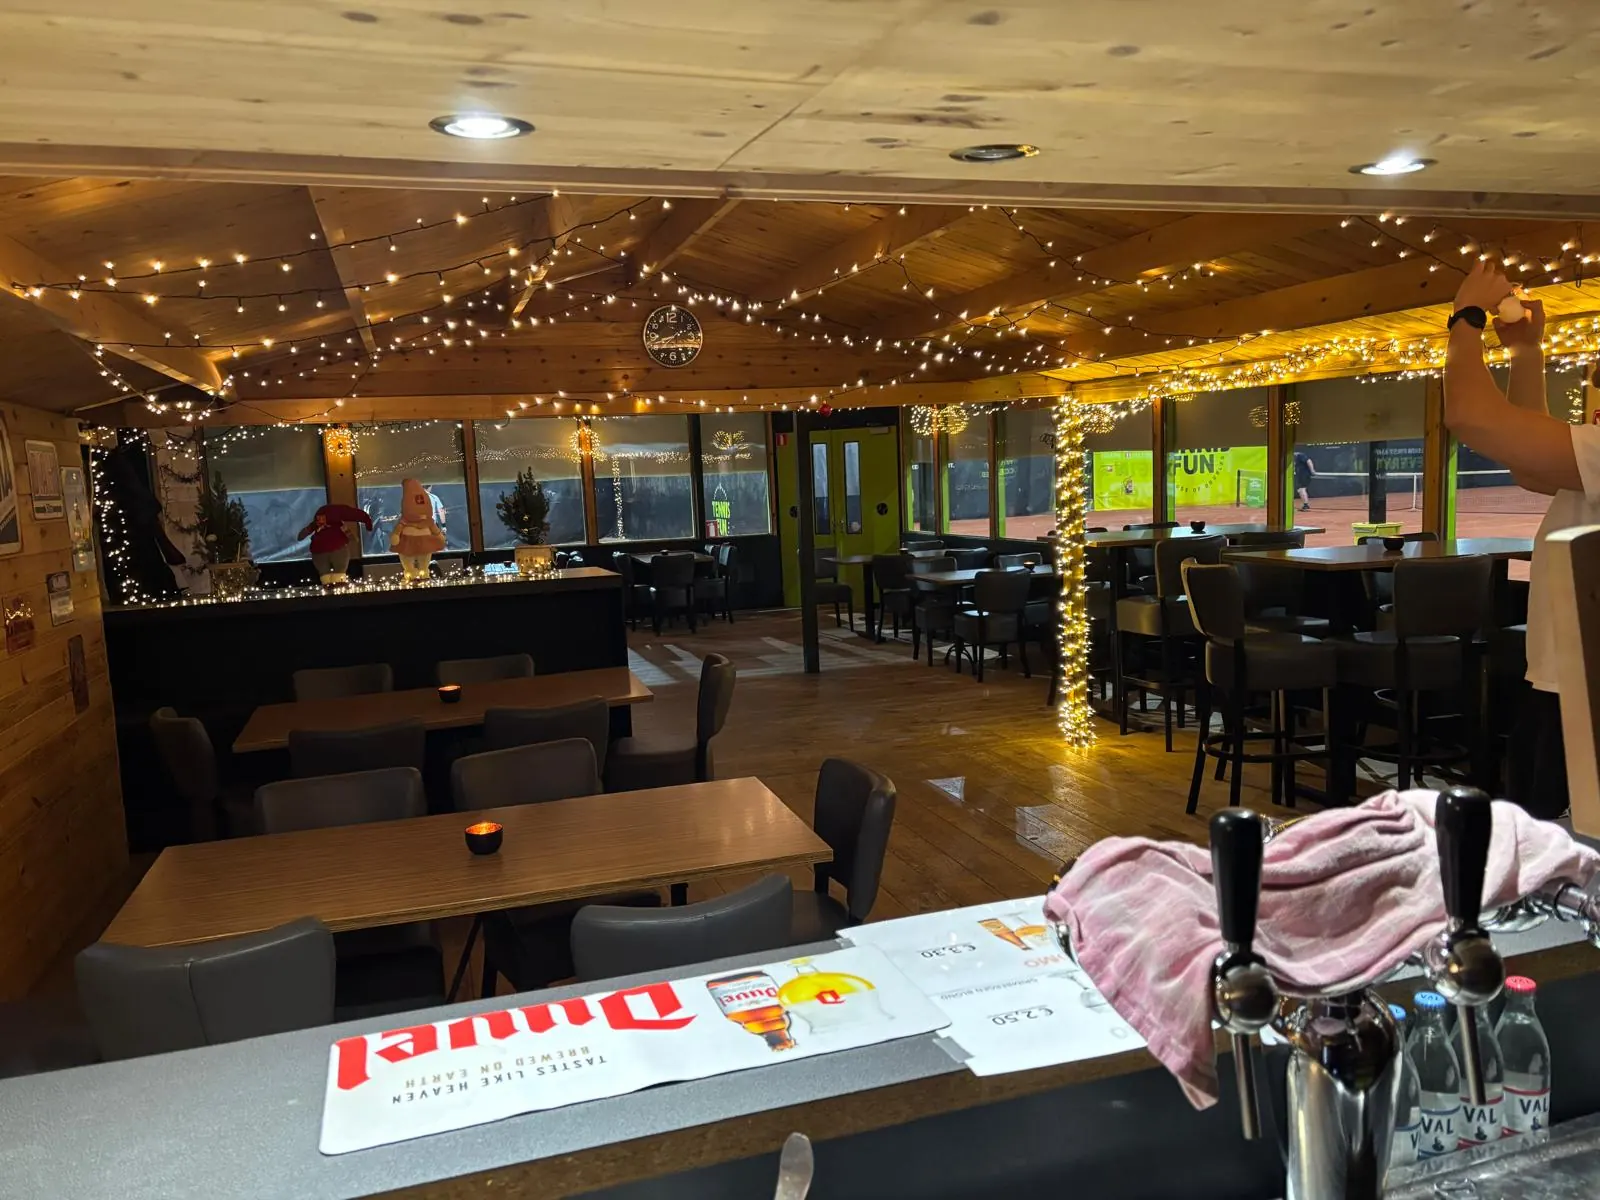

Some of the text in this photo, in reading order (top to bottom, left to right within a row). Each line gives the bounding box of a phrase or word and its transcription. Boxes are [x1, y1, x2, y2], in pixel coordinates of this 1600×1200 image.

[666, 312, 677, 323] 12
[650, 332, 657, 341] 9
[688, 332, 696, 342] 3
[670, 352, 677, 361] 6
[1173, 454, 1215, 475] FUN
[711, 500, 731, 519] TENNIS
[719, 986, 777, 1007] Duvel
[1419, 994, 1439, 1002] VAL
[991, 1008, 1039, 1026] 2,50
[336, 981, 698, 1090] Duvel
[405, 1046, 591, 1089] BREWED ON EARTH
[392, 1055, 608, 1105] TASTES LIKE HEAVEN
[1463, 1106, 1498, 1125] VAL
[1519, 1098, 1549, 1114] VAL
[1420, 1116, 1454, 1135] VAL
